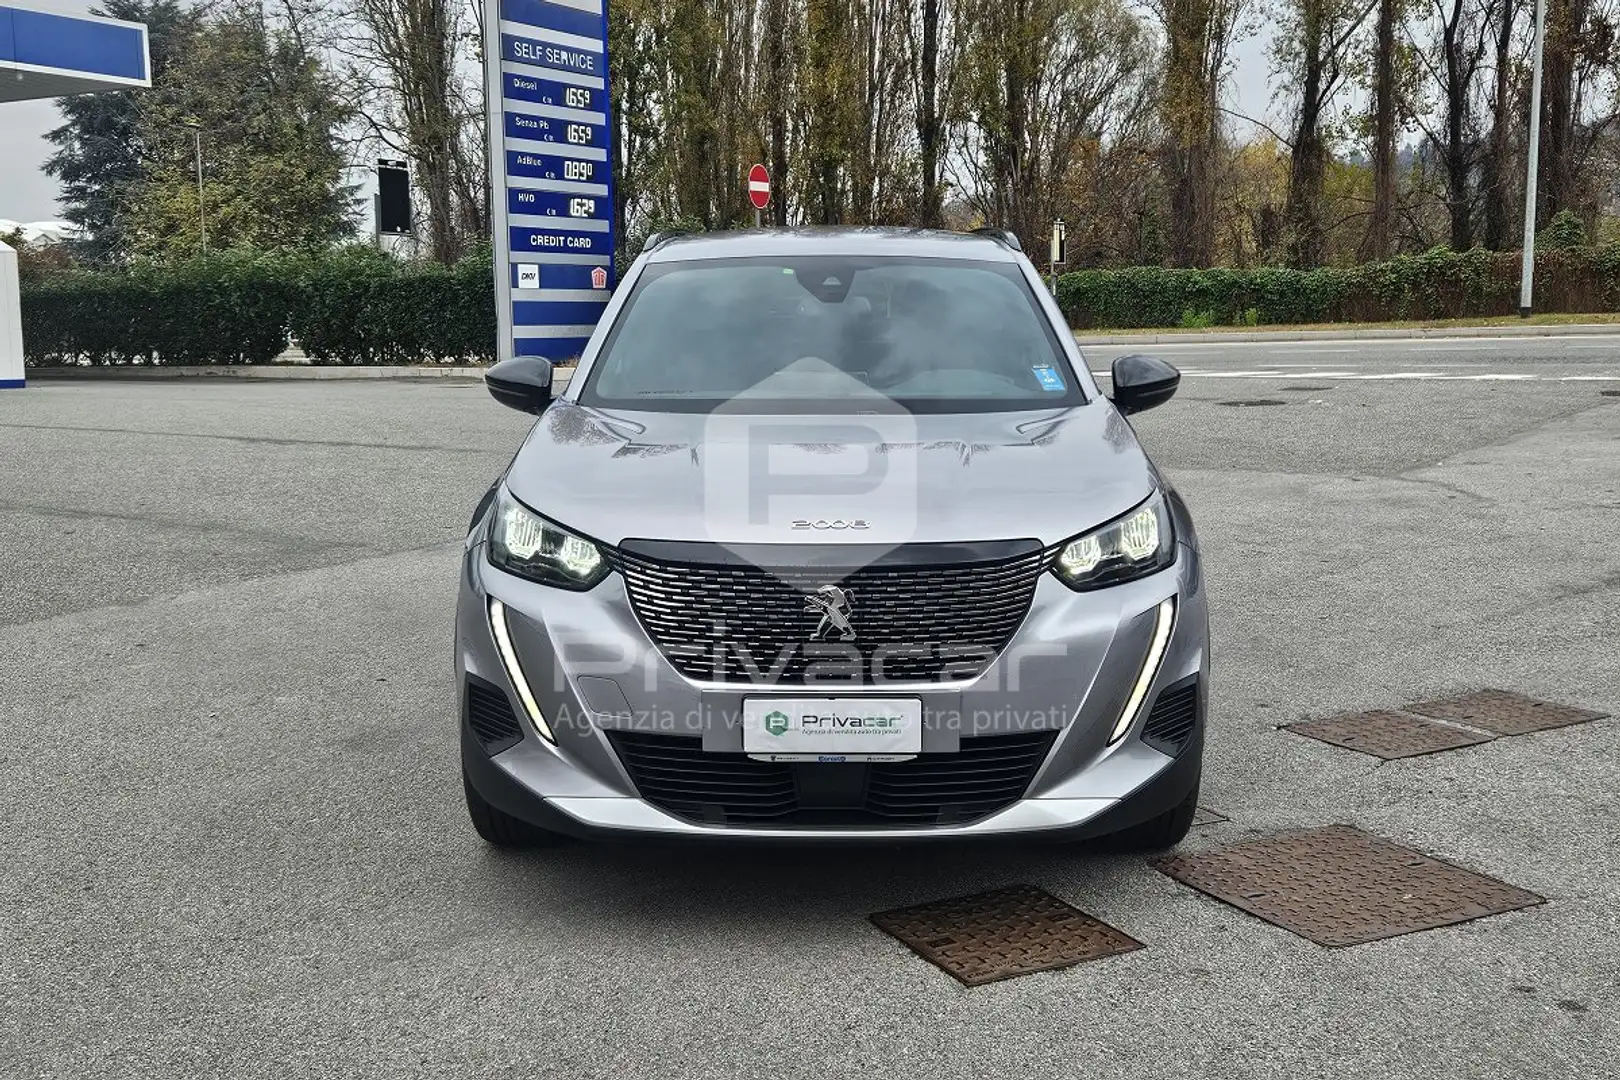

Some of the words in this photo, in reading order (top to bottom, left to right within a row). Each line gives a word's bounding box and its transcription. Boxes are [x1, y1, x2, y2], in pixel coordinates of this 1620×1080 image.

[514, 41, 542, 60] SELF
[546, 47, 594, 70] SERVICE
[513, 78, 537, 90] Diesel
[515, 116, 538, 128] Senza
[539, 120, 550, 130] Pb
[516, 155, 542, 166] AdBlue
[518, 192, 535, 203] HVO
[530, 235, 565, 247] CREDIT
[567, 236, 592, 249] CARD
[521, 272, 536, 281] DKV
[791, 519, 871, 531] 2008
[802, 713, 901, 728] Privacar
